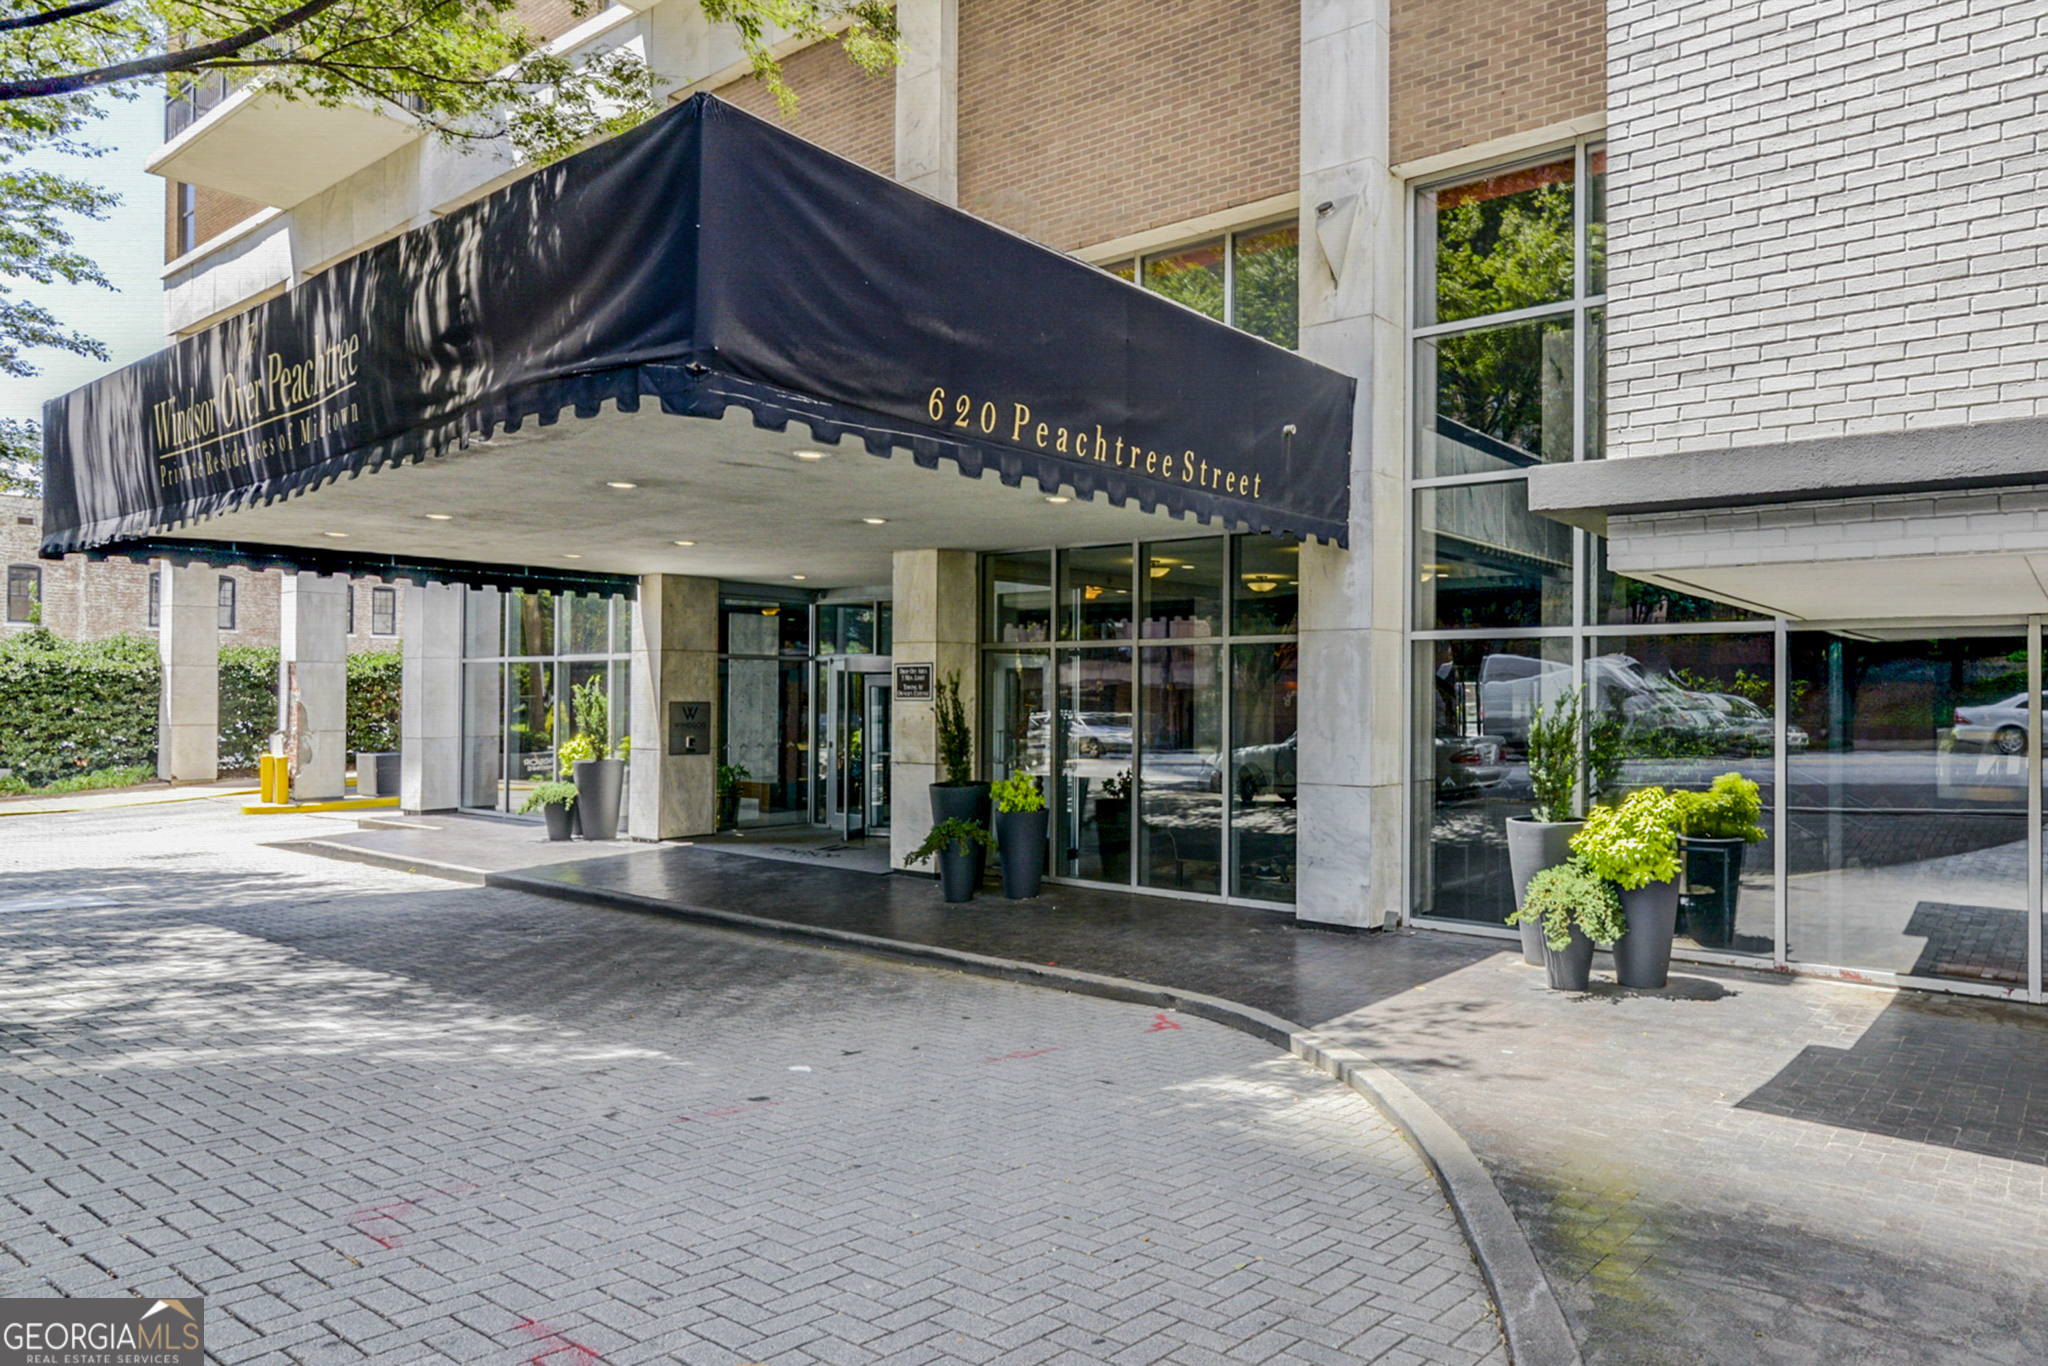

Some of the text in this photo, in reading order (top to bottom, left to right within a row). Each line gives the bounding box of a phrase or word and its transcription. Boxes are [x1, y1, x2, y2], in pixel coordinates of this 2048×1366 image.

[154, 333, 360, 450] Windsor Over Peachtree
[160, 403, 359, 488] Private Residences of Midtown
[928, 387, 1262, 499] 620 Peachtree Street
[682, 706, 699, 720] W
